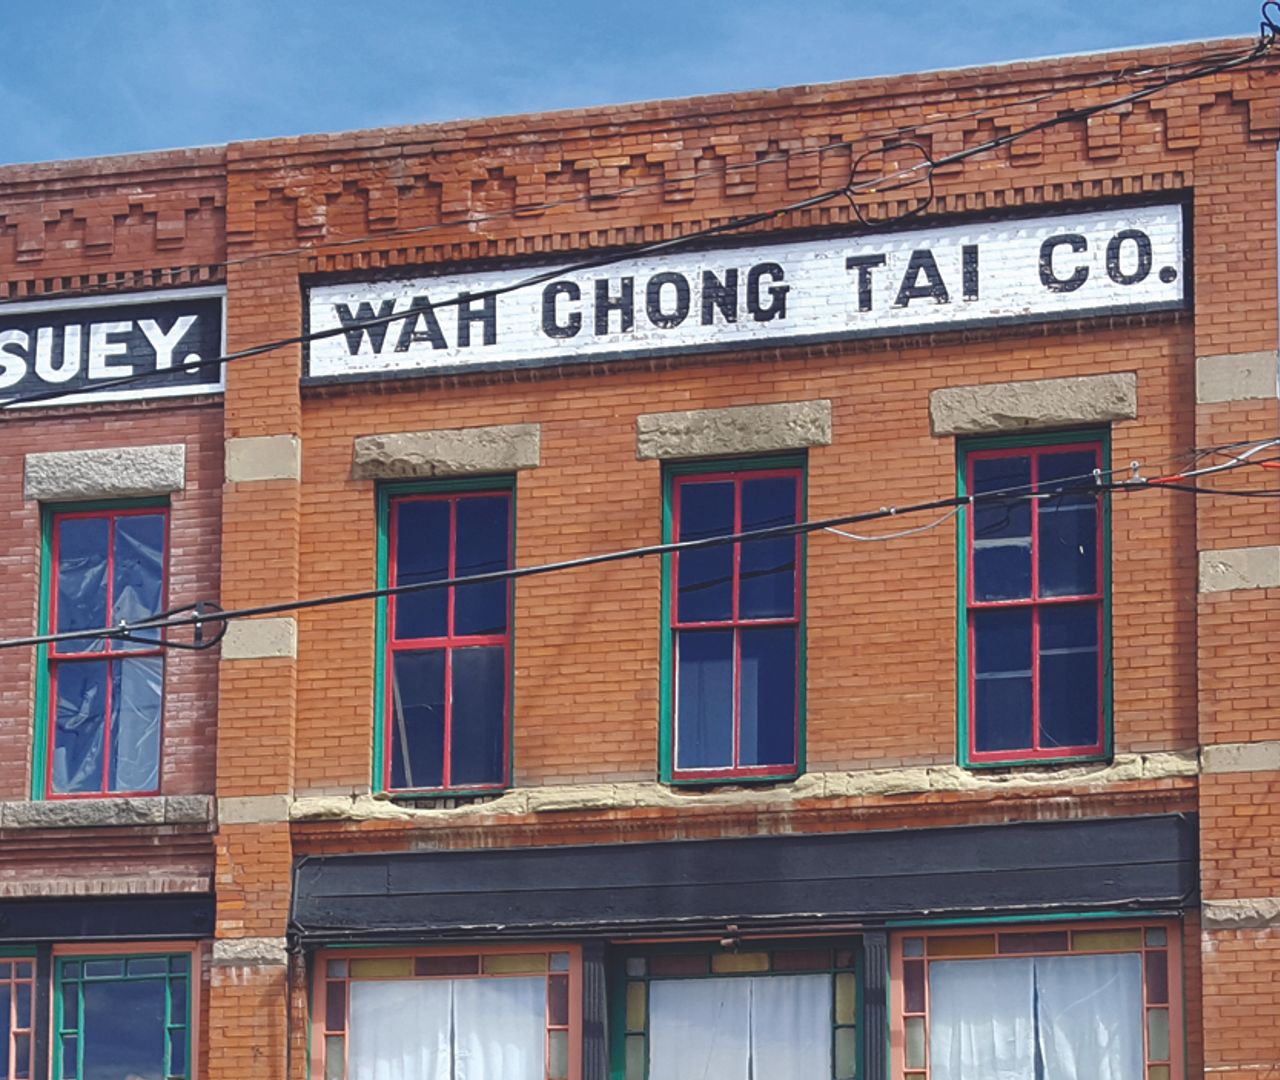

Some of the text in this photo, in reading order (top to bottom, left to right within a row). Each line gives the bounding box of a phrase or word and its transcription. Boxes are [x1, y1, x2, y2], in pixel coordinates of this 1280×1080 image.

[333, 229, 1179, 356] WAH CHONG TAI CO.
